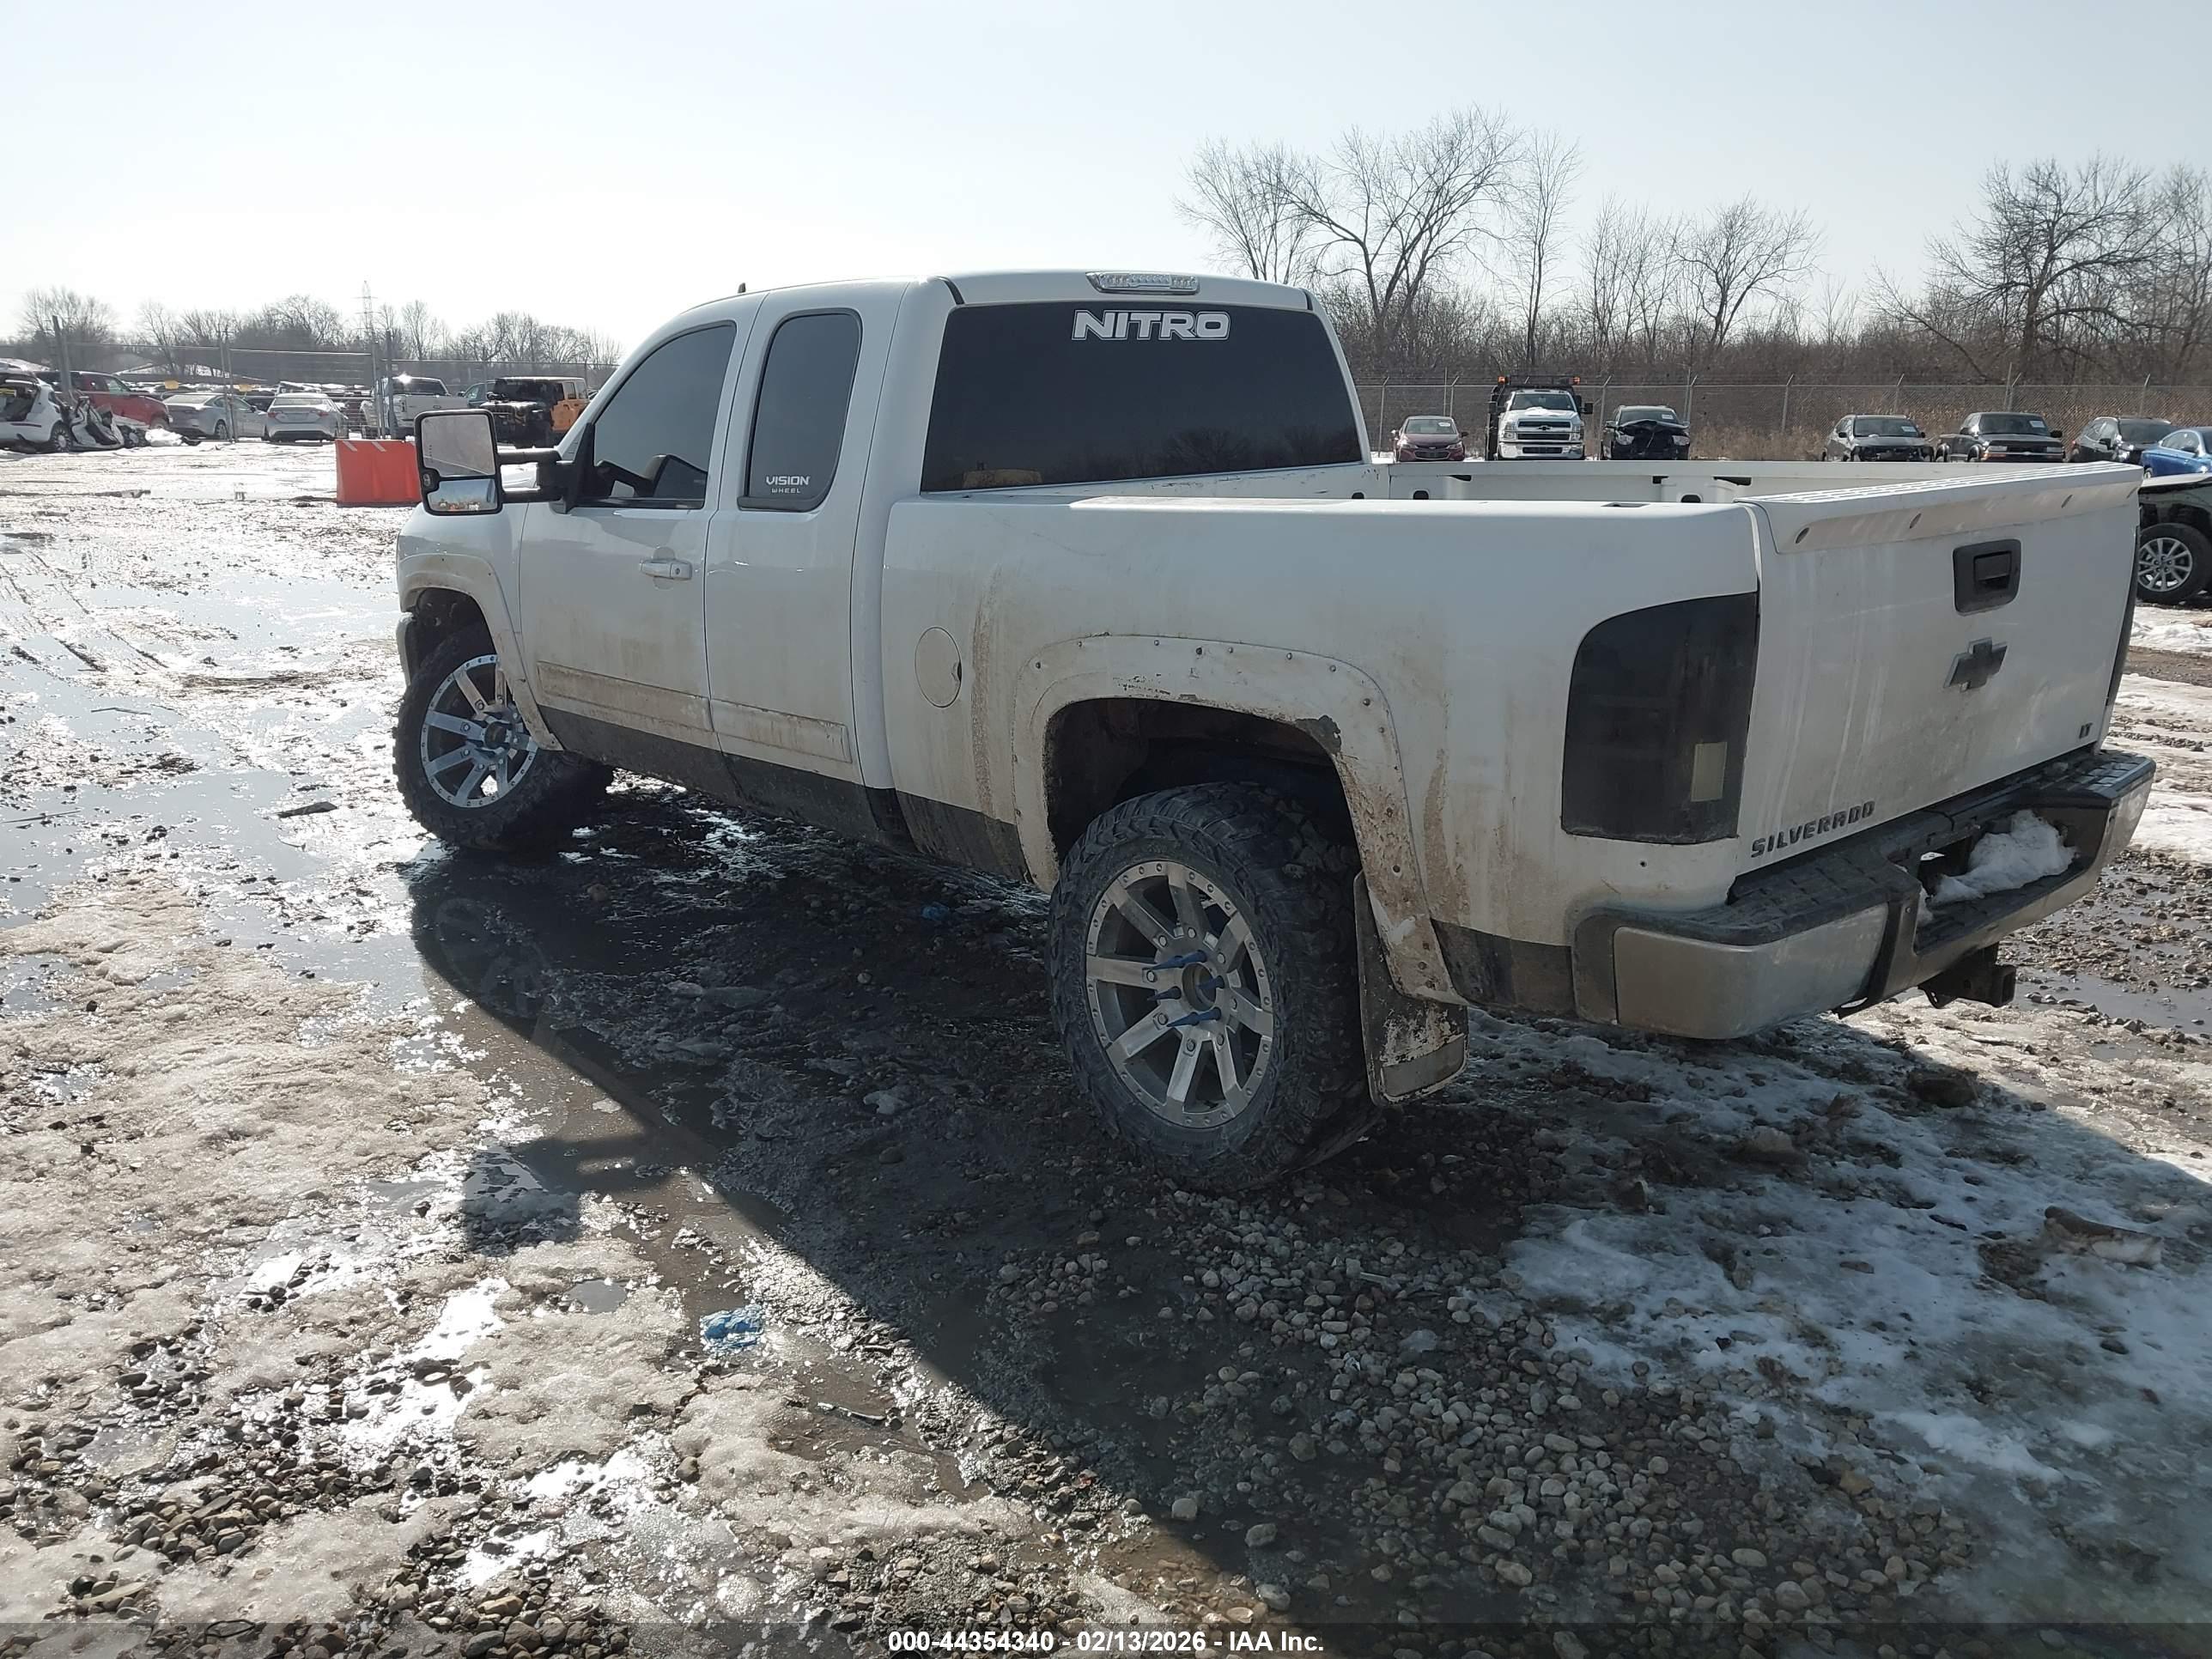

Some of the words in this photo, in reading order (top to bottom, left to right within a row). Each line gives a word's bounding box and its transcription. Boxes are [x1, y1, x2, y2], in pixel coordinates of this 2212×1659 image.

[1072, 309, 1231, 340] NITRO
[766, 476, 810, 485] VISION
[1751, 800, 1876, 858] SILVERADO
